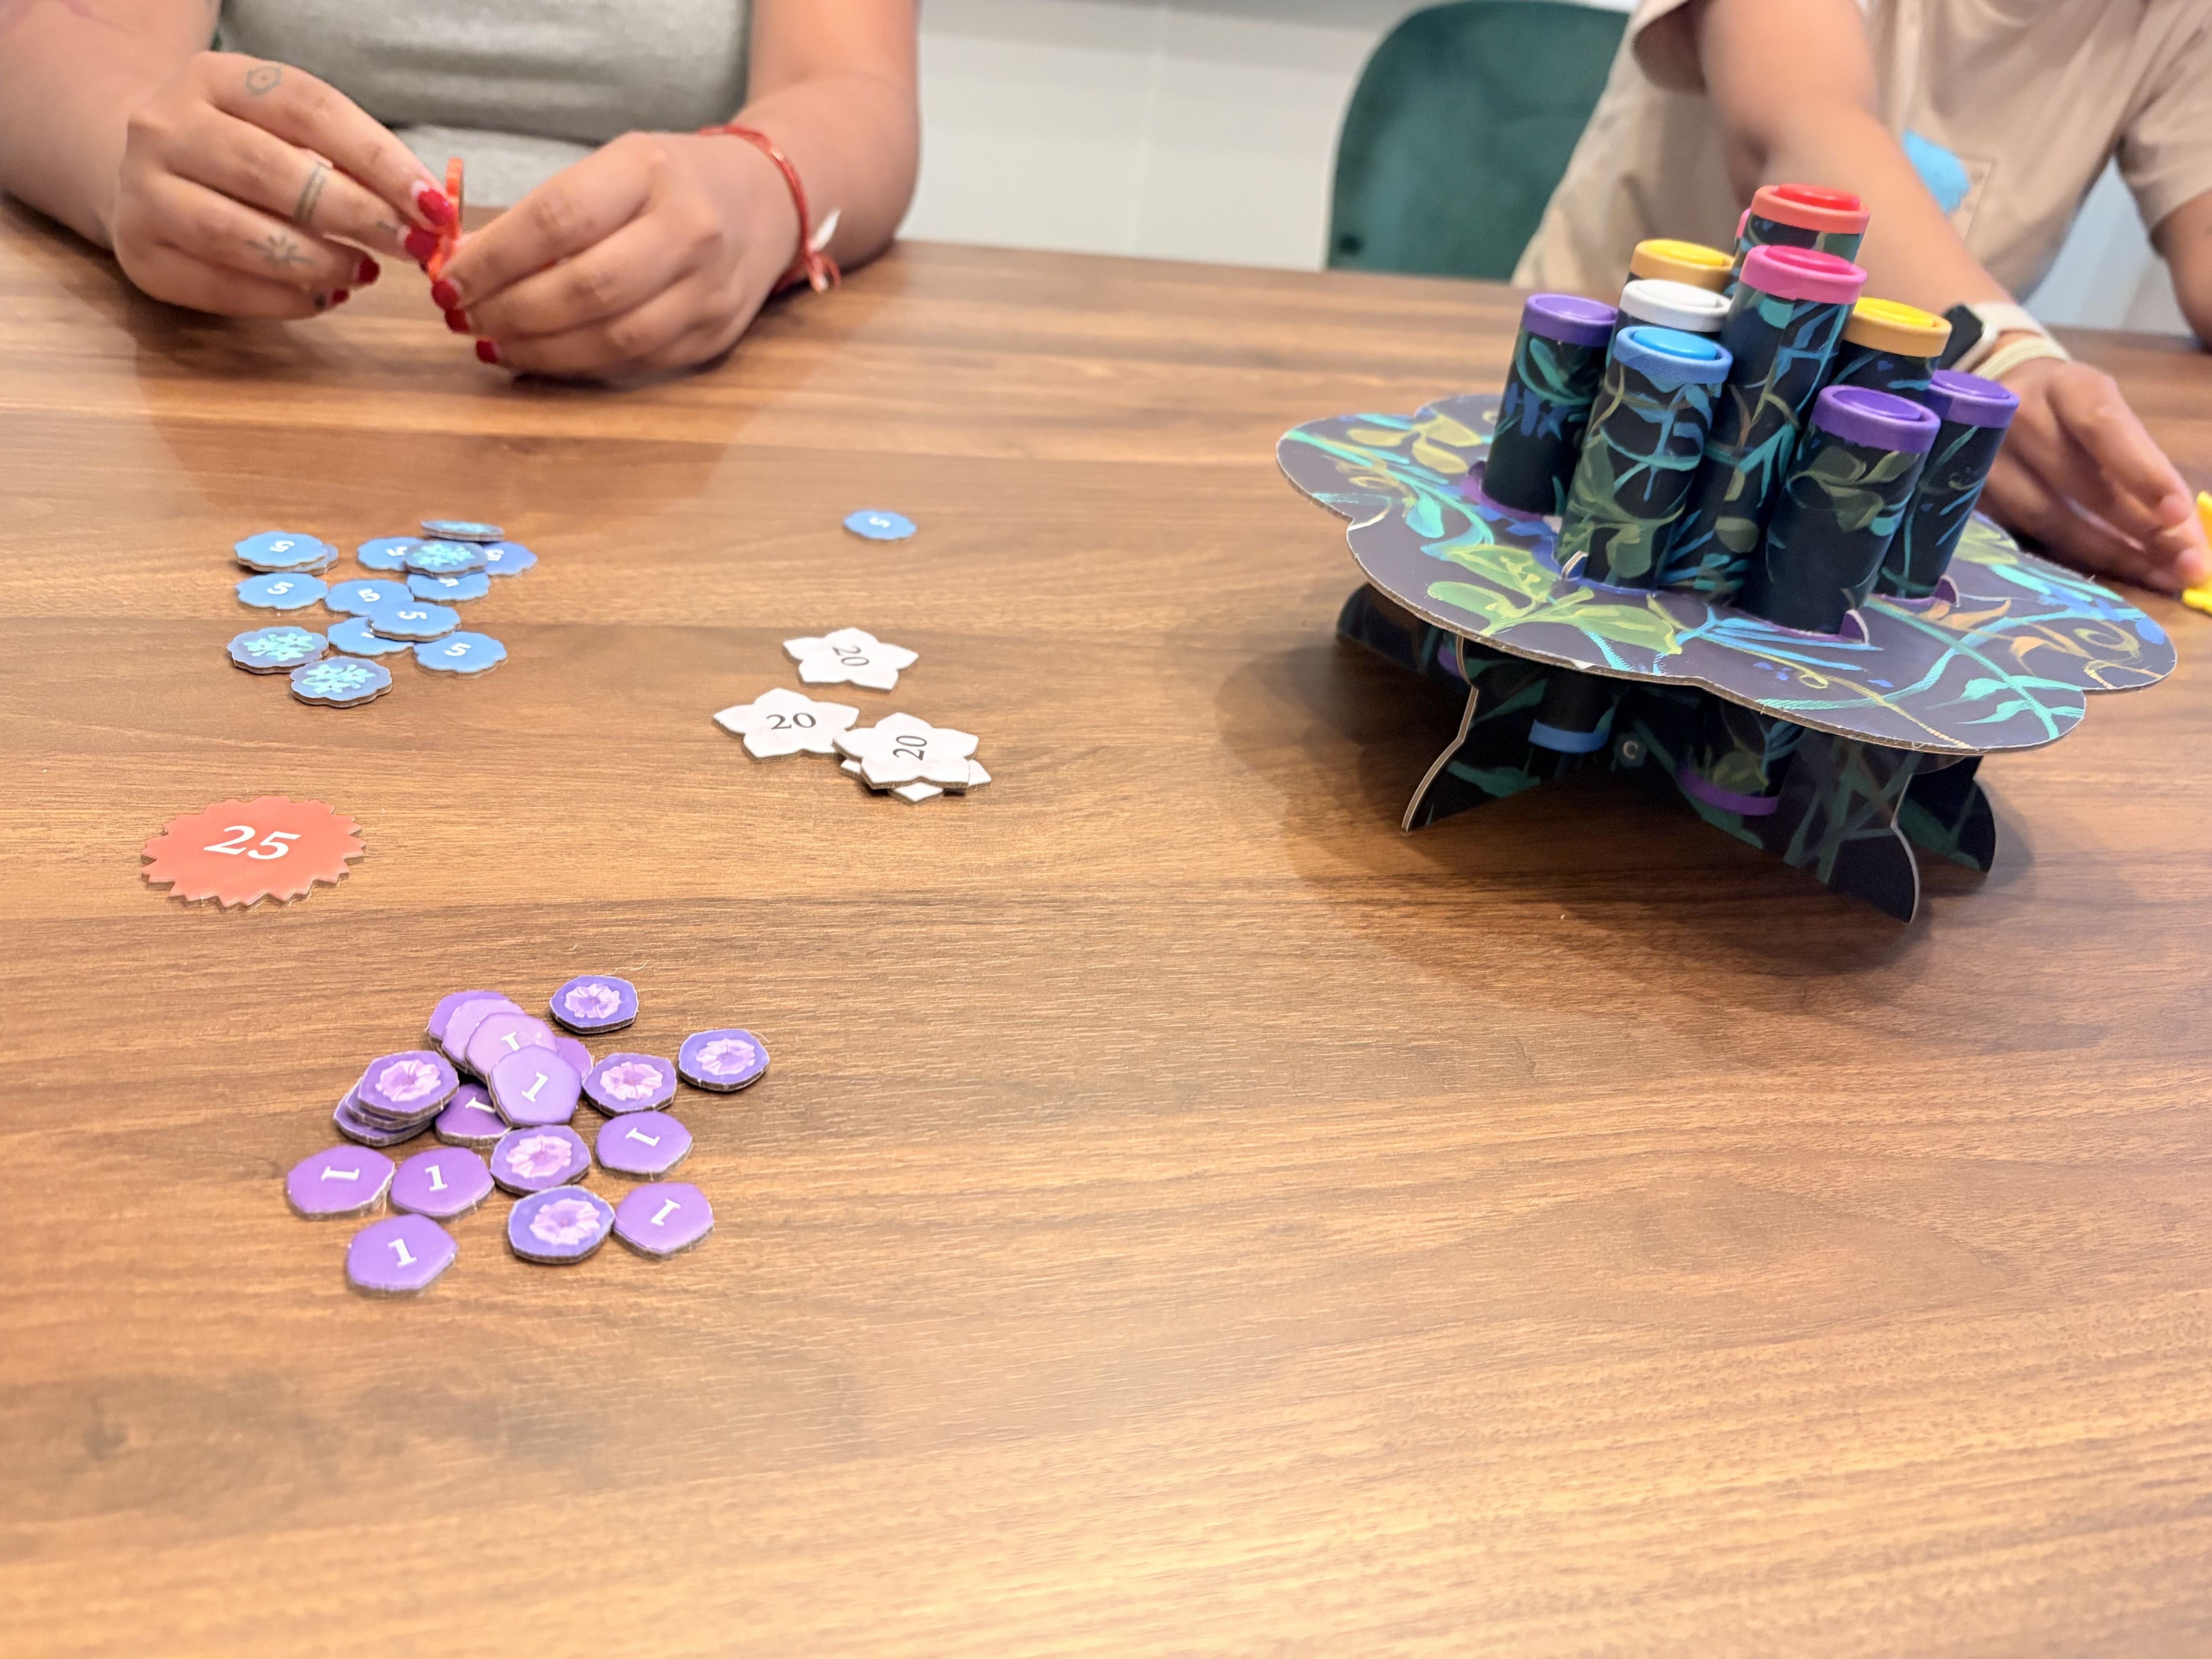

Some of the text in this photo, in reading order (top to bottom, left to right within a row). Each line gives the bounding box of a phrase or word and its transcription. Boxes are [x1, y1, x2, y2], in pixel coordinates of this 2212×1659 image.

[270, 541, 295, 552] 5
[267, 582, 294, 594] 5
[359, 589, 380, 602] 5
[398, 611, 427, 620] 5
[444, 642, 471, 656] 5
[832, 647, 870, 666] 20
[766, 713, 816, 730] 20
[892, 735, 927, 761] 20
[203, 825, 301, 860] 25
[521, 1072, 548, 1103] 1
[625, 1127, 660, 1146] 1
[321, 1166, 360, 1180] 1
[425, 1165, 448, 1191] 1
[651, 1199, 681, 1226] 1
[388, 1238, 417, 1266] 1
